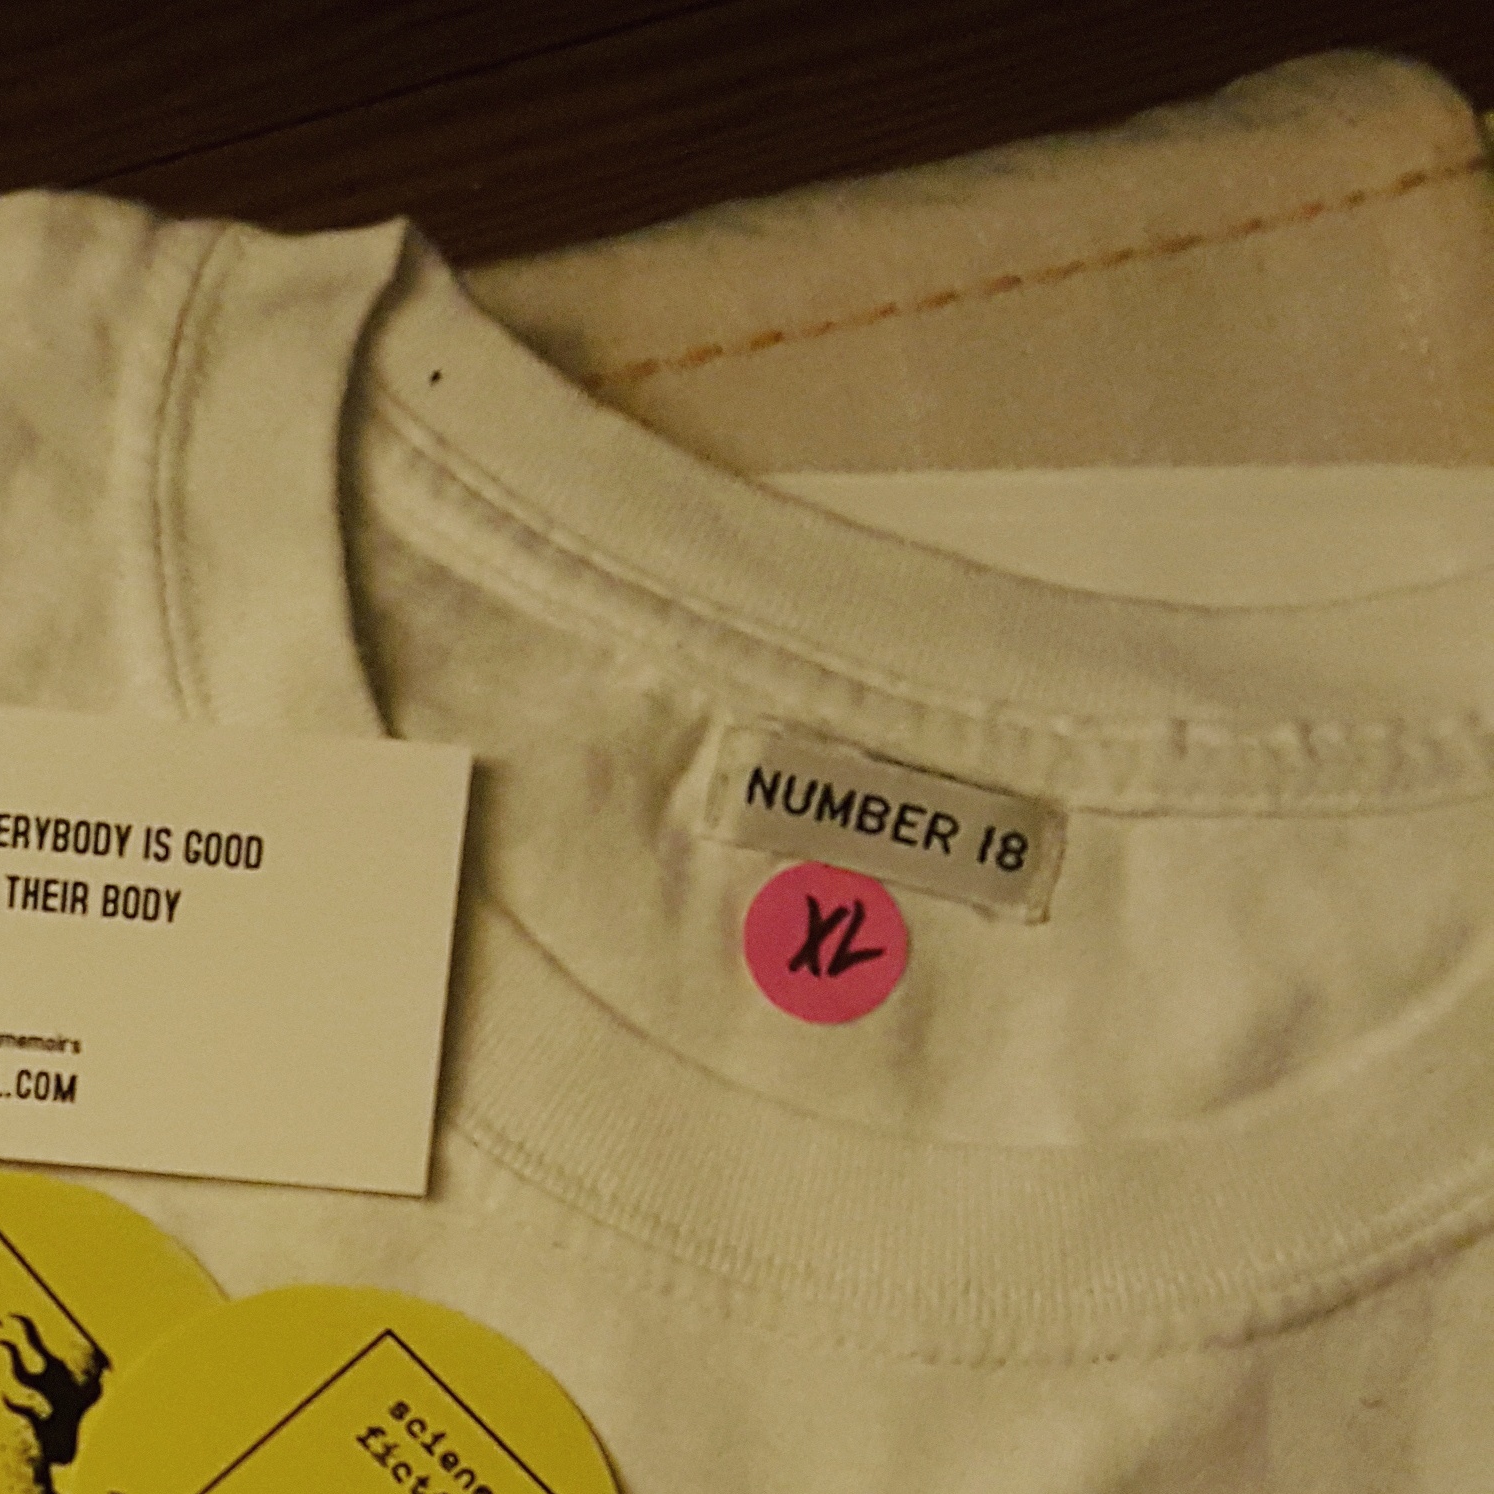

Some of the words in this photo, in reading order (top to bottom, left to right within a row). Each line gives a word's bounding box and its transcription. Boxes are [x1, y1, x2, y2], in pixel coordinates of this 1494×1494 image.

[142, 825, 173, 864] IS
[183, 828, 265, 871] GOOD
[745, 765, 961, 857] NUMBER
[975, 824, 1031, 875] 18
[5, 874, 90, 916] THEIR
[100, 883, 183, 924] BODY
[787, 894, 885, 978] XL
